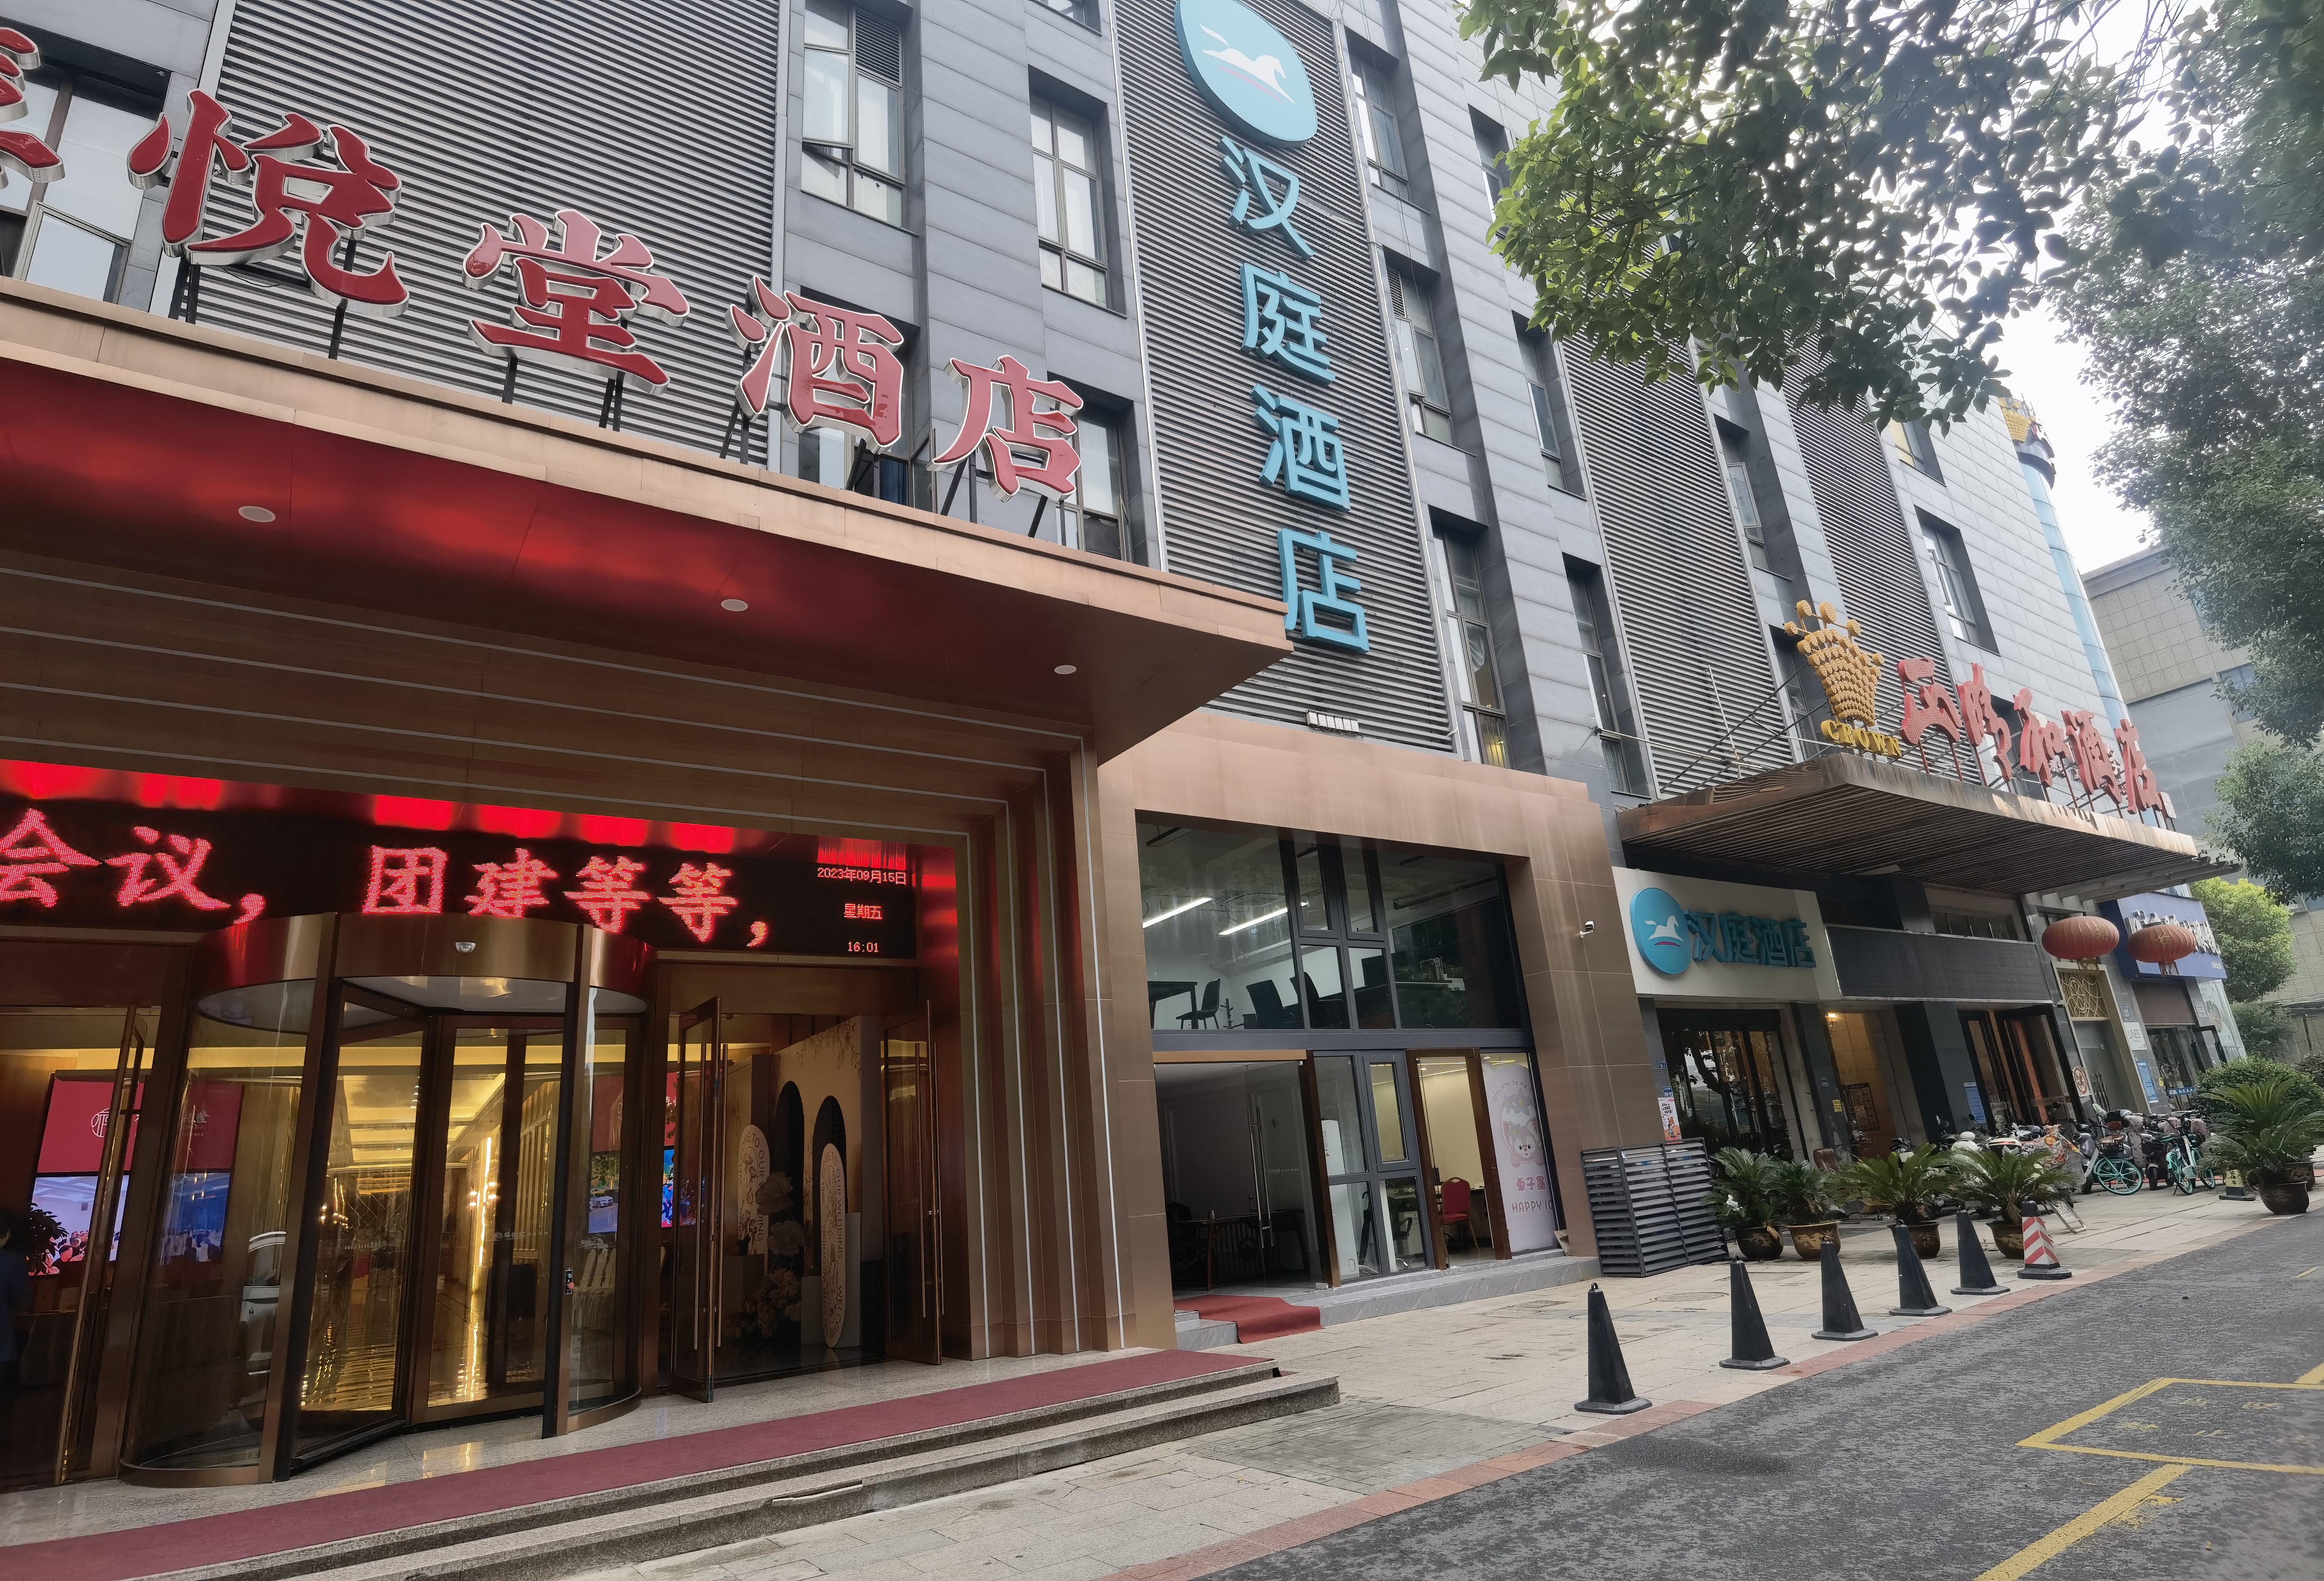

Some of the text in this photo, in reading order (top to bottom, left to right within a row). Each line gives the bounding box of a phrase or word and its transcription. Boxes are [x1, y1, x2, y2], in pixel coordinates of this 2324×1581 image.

[1217, 134, 1370, 653] 汉庭酒店
[1821, 719, 1902, 758] CROWN
[817, 867, 906, 885] 2023年09月15日
[844, 903, 883, 920] 星期五
[848, 941, 878, 952] 16:01
[1682, 909, 1817, 968] 汉庭酒店
[1512, 1200, 1542, 1214] HAPPY
